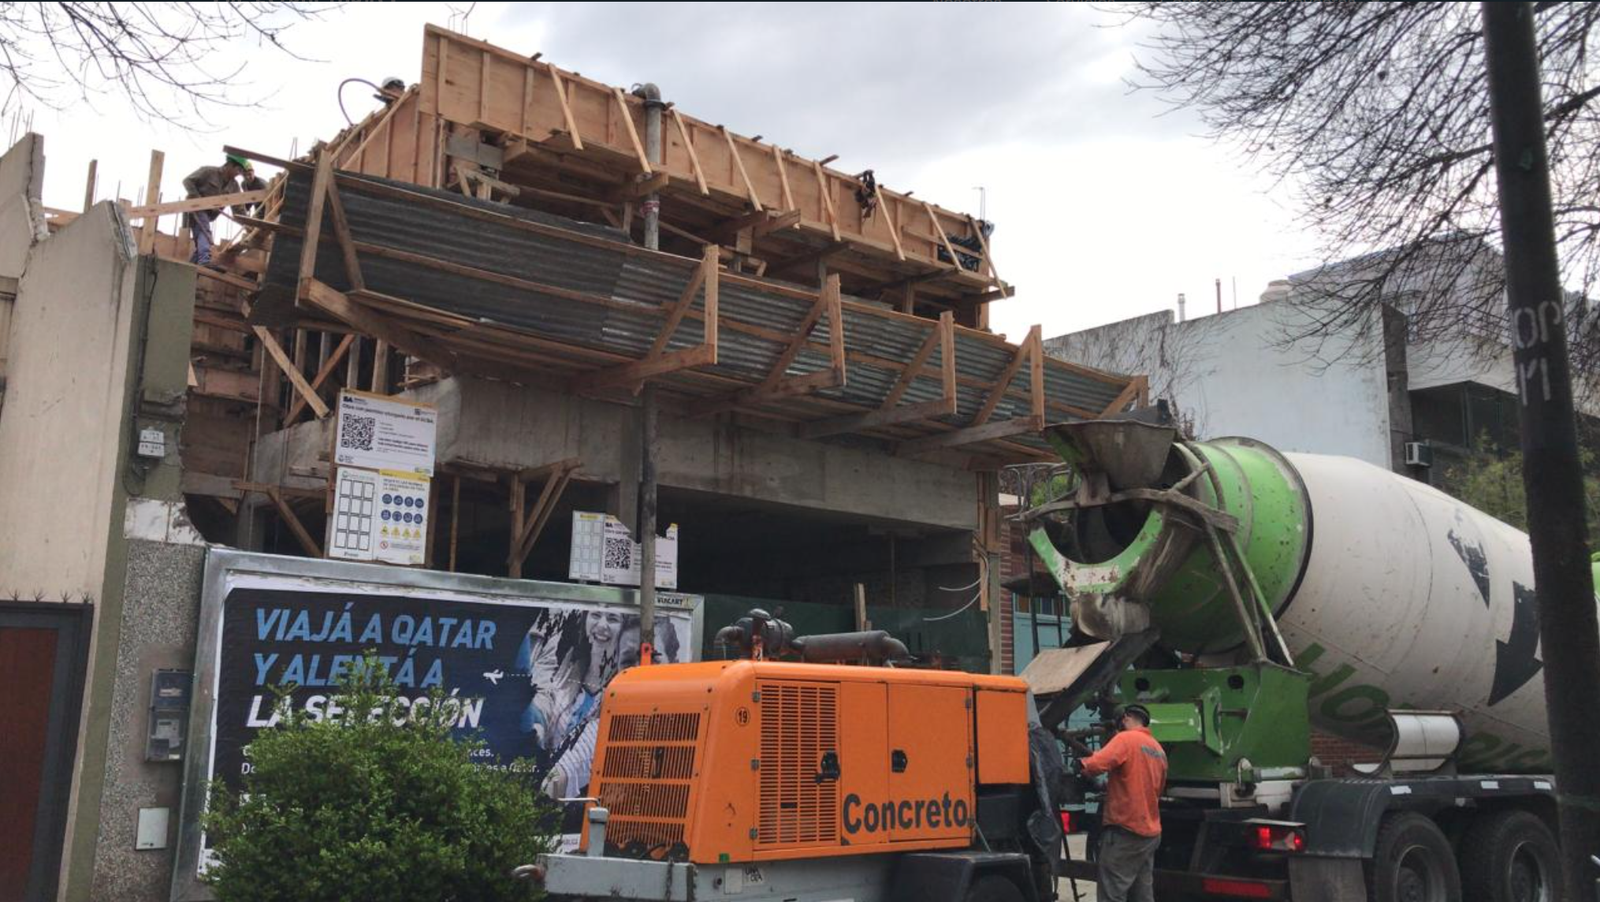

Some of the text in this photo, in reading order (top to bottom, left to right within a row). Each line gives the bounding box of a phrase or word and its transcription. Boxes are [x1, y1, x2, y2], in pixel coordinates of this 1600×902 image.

[256, 602, 497, 650] VIAJÁ A QATAR
[254, 653, 279, 686] Y
[419, 658, 443, 689] A
[246, 694, 293, 728] LA
[739, 710, 748, 724] 19
[843, 791, 968, 834] Concreto
